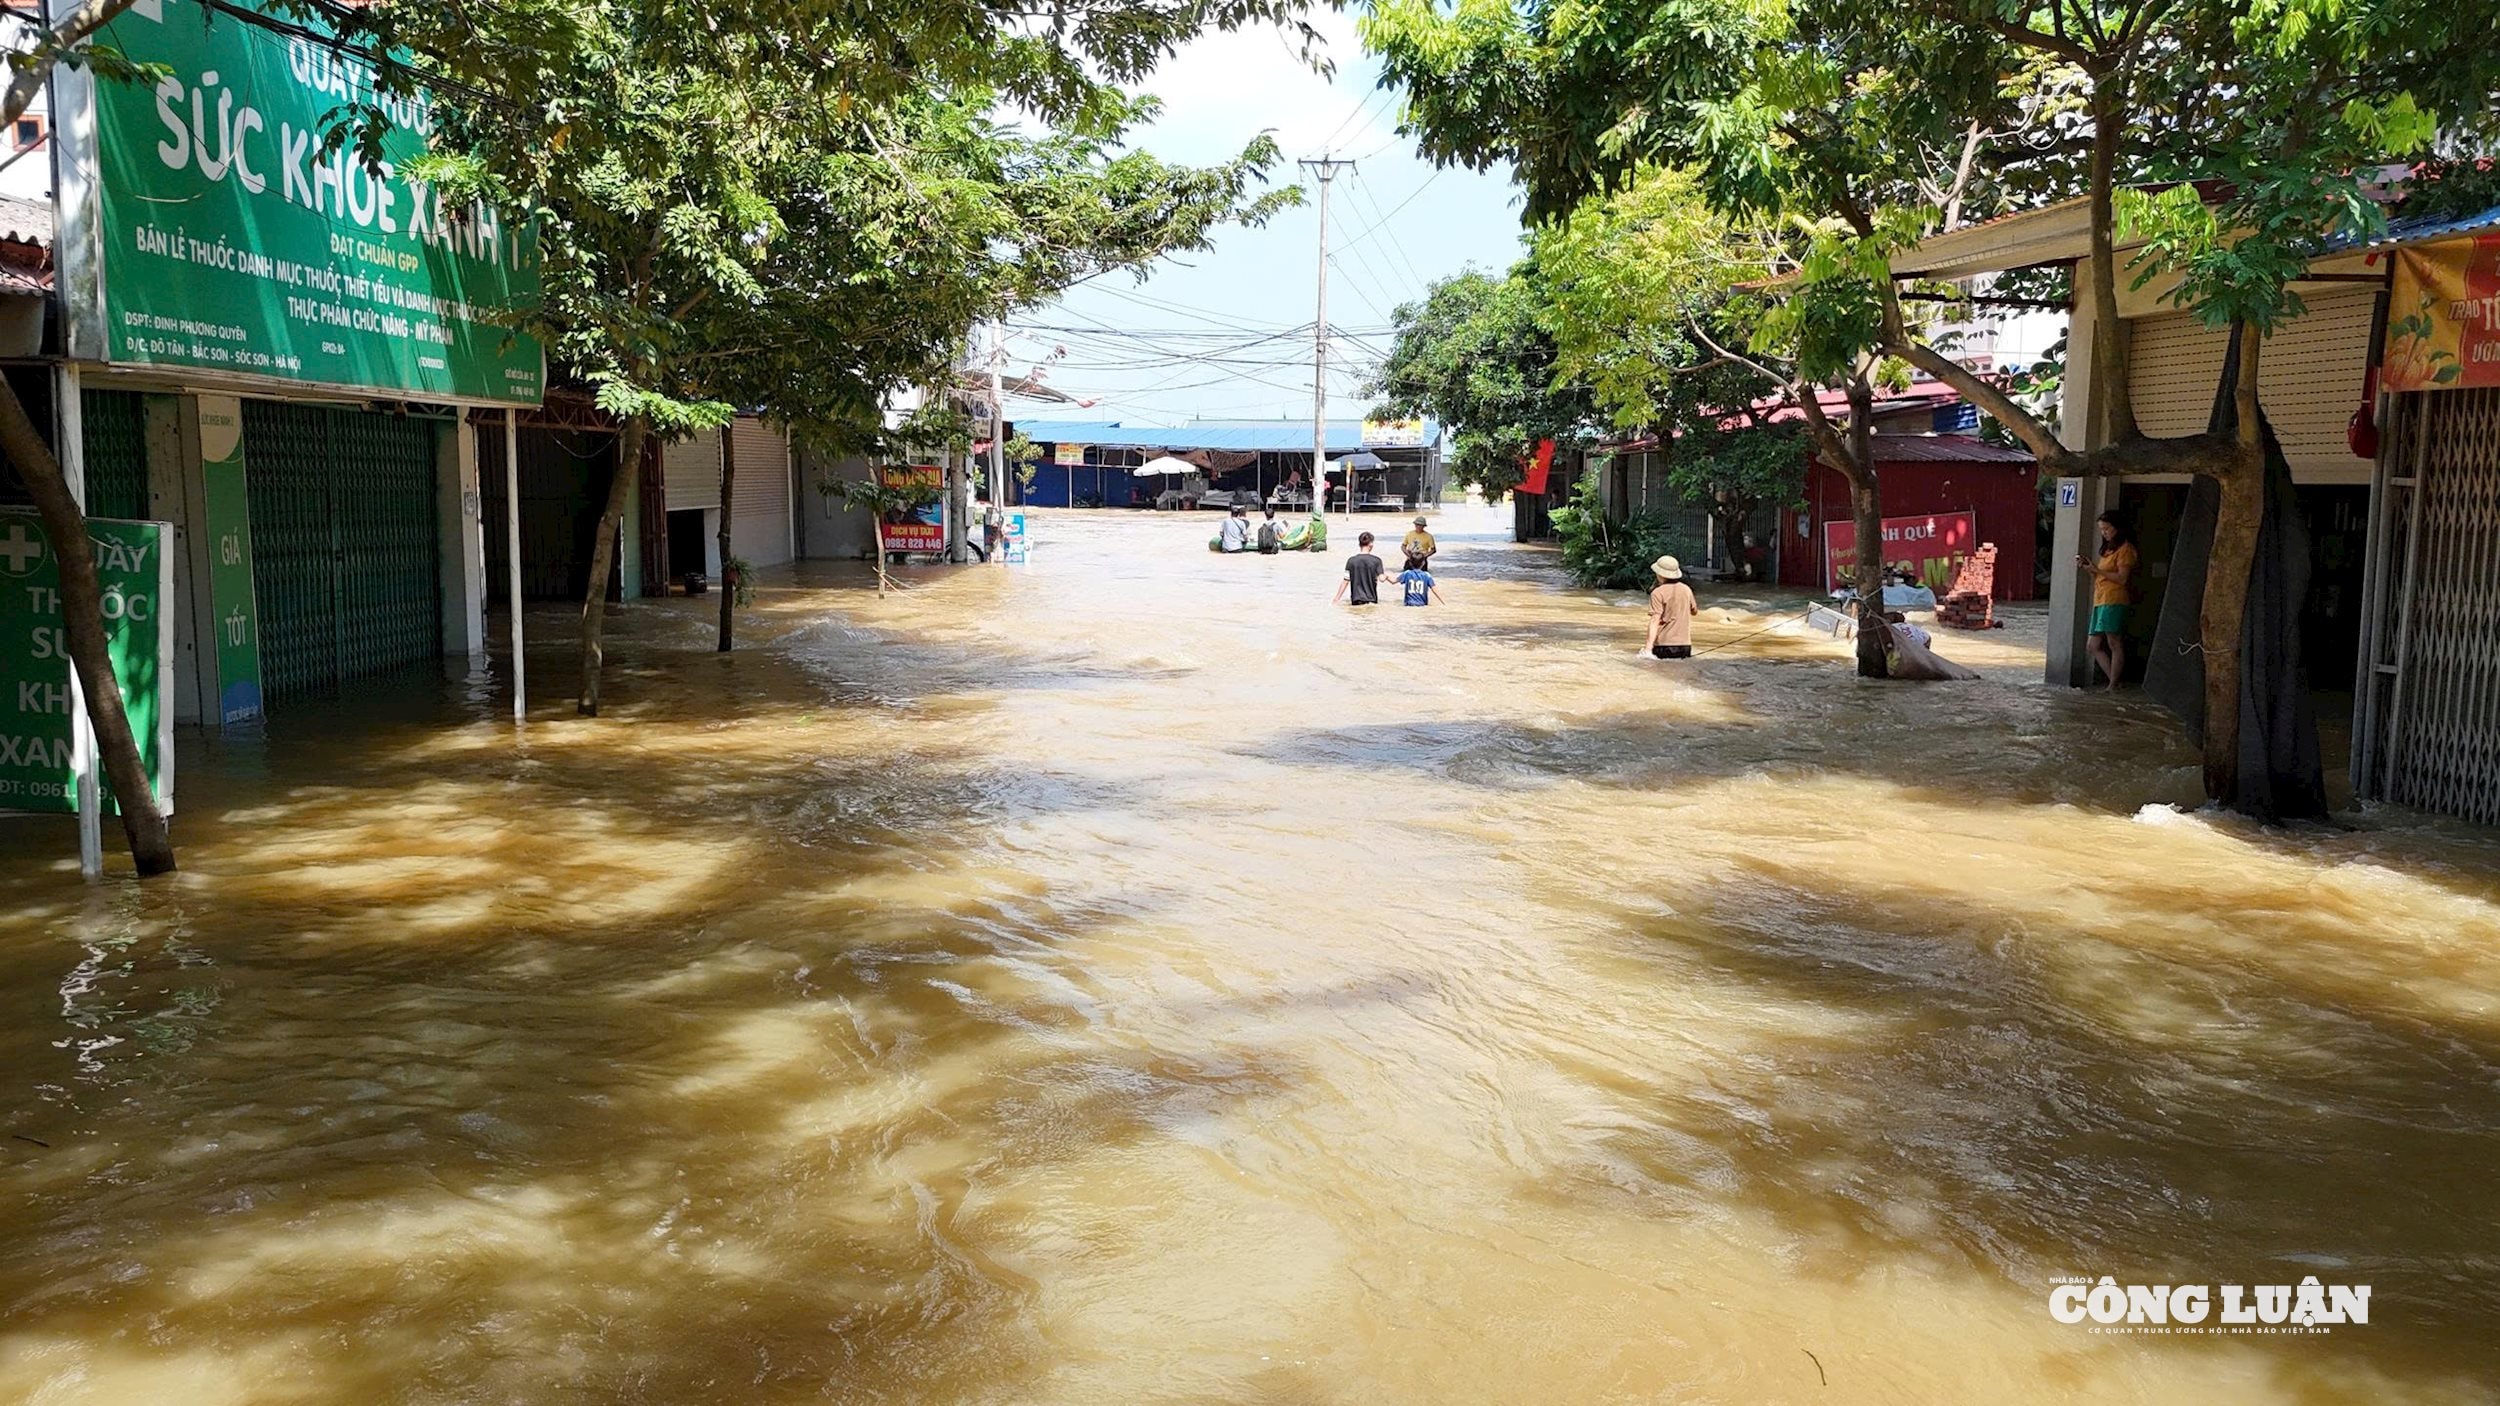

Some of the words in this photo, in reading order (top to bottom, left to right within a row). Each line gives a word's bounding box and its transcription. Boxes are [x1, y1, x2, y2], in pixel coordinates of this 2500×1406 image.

[156, 70, 266, 194] SỨC
[330, 232, 354, 261] ĐẠT
[357, 235, 395, 268] CHUẨN
[398, 252, 418, 273] GPP
[136, 223, 167, 256] BÁN
[171, 226, 186, 260] LẺ
[188, 234, 235, 271] THUỐC
[238, 251, 273, 279] DANH
[276, 260, 303, 289] MỤC
[304, 261, 341, 292] THUỐC
[343, 268, 370, 299] THIẾT
[372, 273, 389, 304] YẾU
[391, 283, 405, 308] VÀ
[405, 290, 431, 313] DANH
[451, 296, 478, 323] THUỐC
[125, 312, 152, 328] DSPT:
[179, 320, 217, 337] PHƯƠNG
[288, 296, 318, 326] THỰC
[320, 290, 351, 327] PHẨM
[353, 307, 380, 333] CHỨC
[381, 312, 408, 338] NĂNG
[415, 319, 429, 341] MỸ
[430, 317, 454, 345] PHẨM
[2448, 299, 2480, 320] TRAO
[127, 337, 149, 353] Đ/C:
[166, 339, 185, 356] TÂN
[210, 347, 229, 361] SƠN
[235, 348, 251, 364] SÓC
[252, 352, 270, 367] SƠN
[275, 354, 287, 369] HÀ
[2063, 485, 2075, 504] 72
[221, 526, 241, 565] GIÁ
[885, 537, 906, 549] 0982
[908, 538, 924, 549] 828
[925, 538, 942, 549] 446
[225, 603, 247, 647] TỐT
